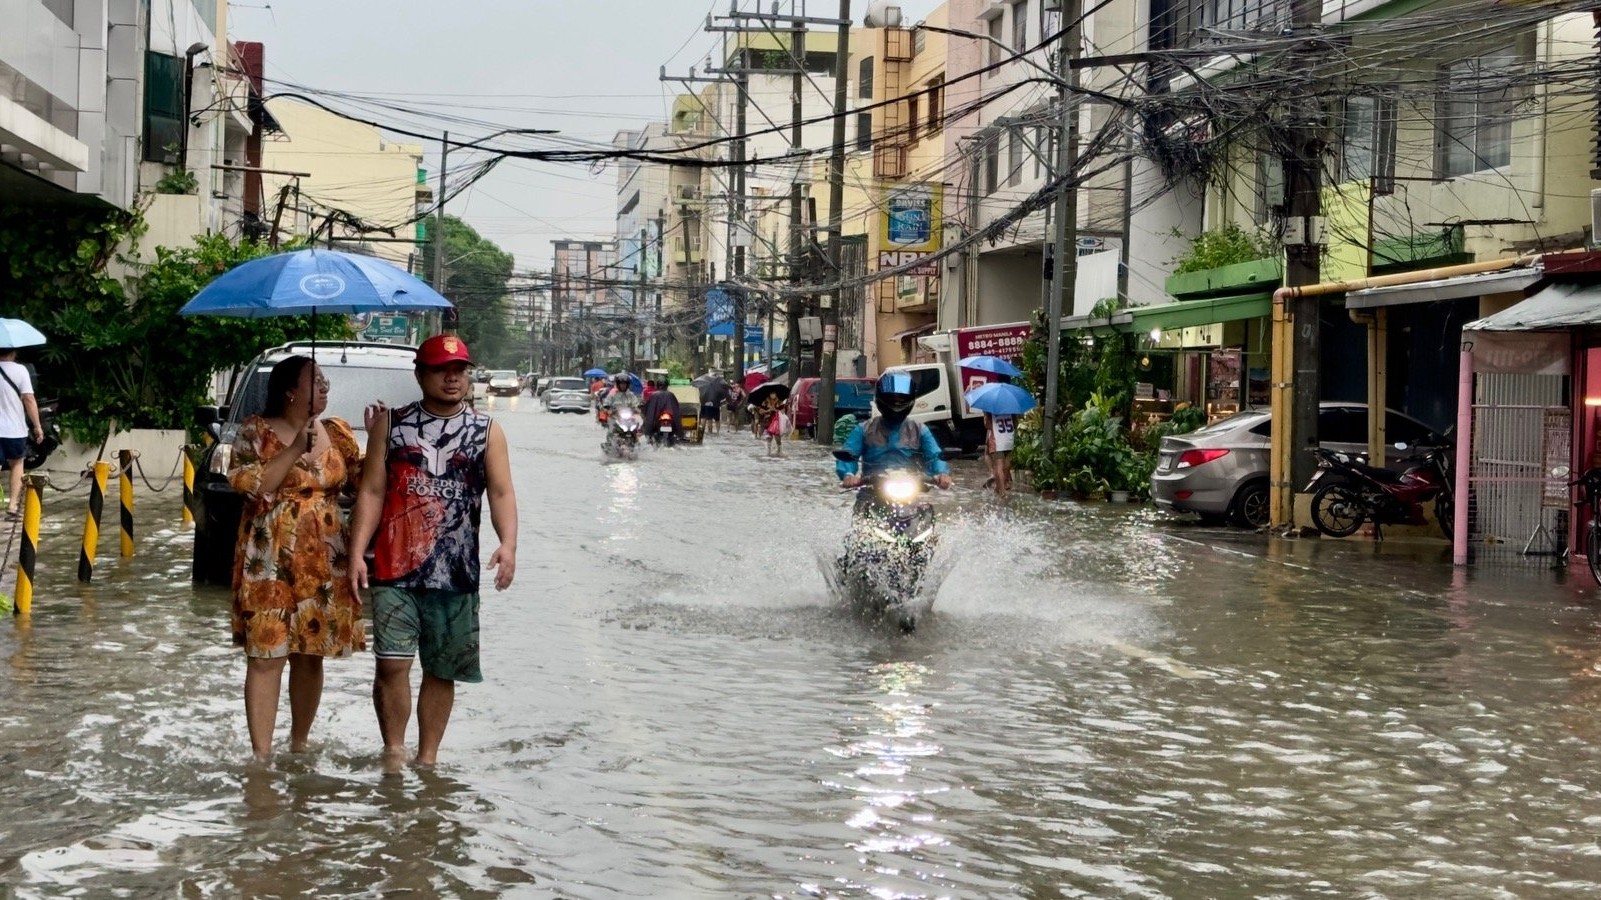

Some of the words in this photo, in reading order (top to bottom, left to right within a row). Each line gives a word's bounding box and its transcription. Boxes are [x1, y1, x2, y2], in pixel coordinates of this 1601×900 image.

[975, 332, 993, 340] METRO
[993, 330, 1013, 338] MANILA
[968, 336, 1023, 350] 8884-8888
[996, 418, 1014, 433] 35
[406, 484, 463, 500] FORCE
